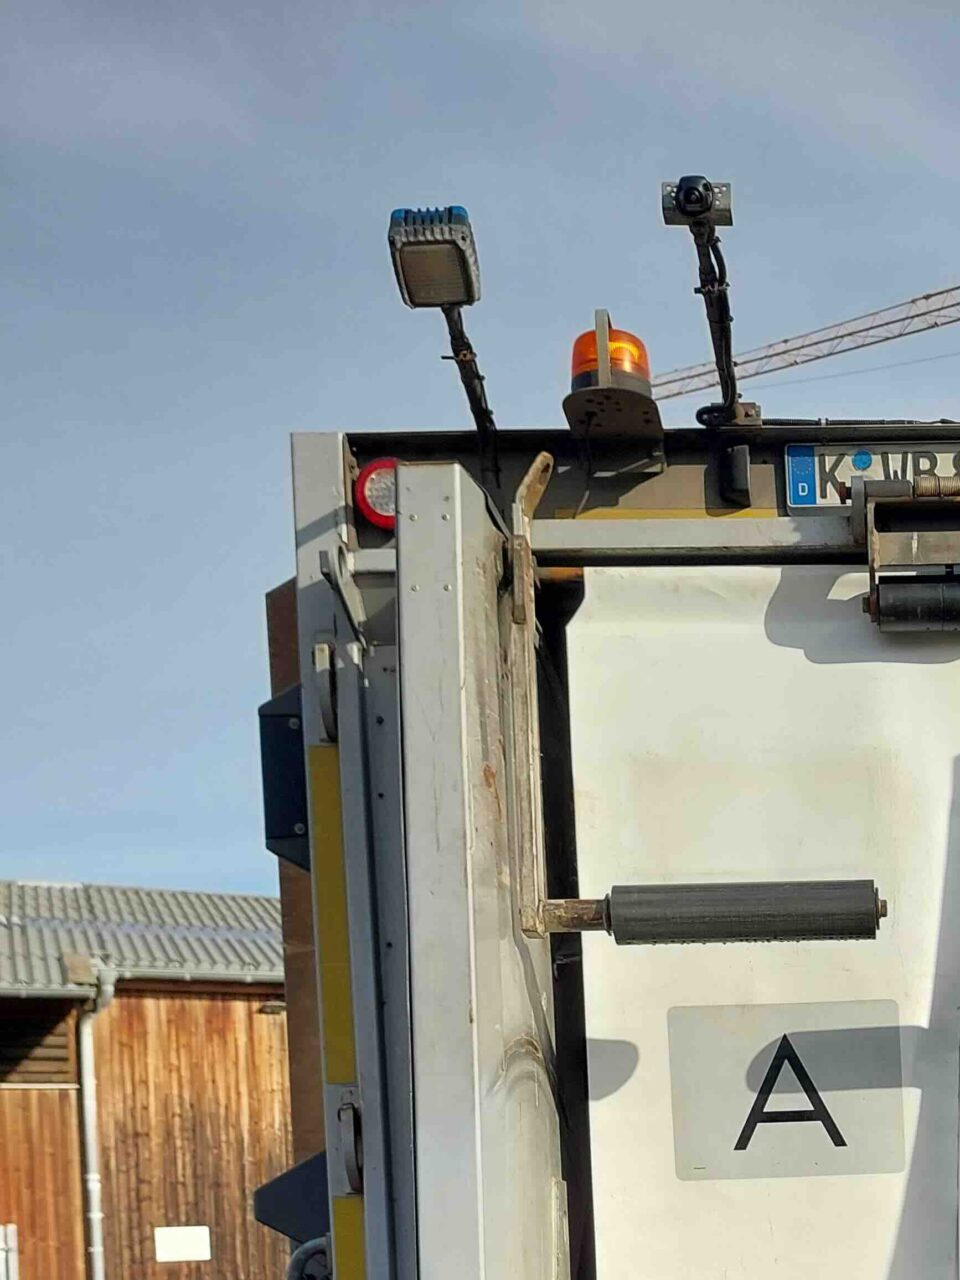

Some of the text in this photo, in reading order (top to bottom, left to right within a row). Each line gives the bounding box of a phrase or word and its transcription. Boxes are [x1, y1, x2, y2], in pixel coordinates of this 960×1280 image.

[799, 483, 808, 496] D
[819, 452, 847, 499] K
[733, 1033, 847, 1151] A
